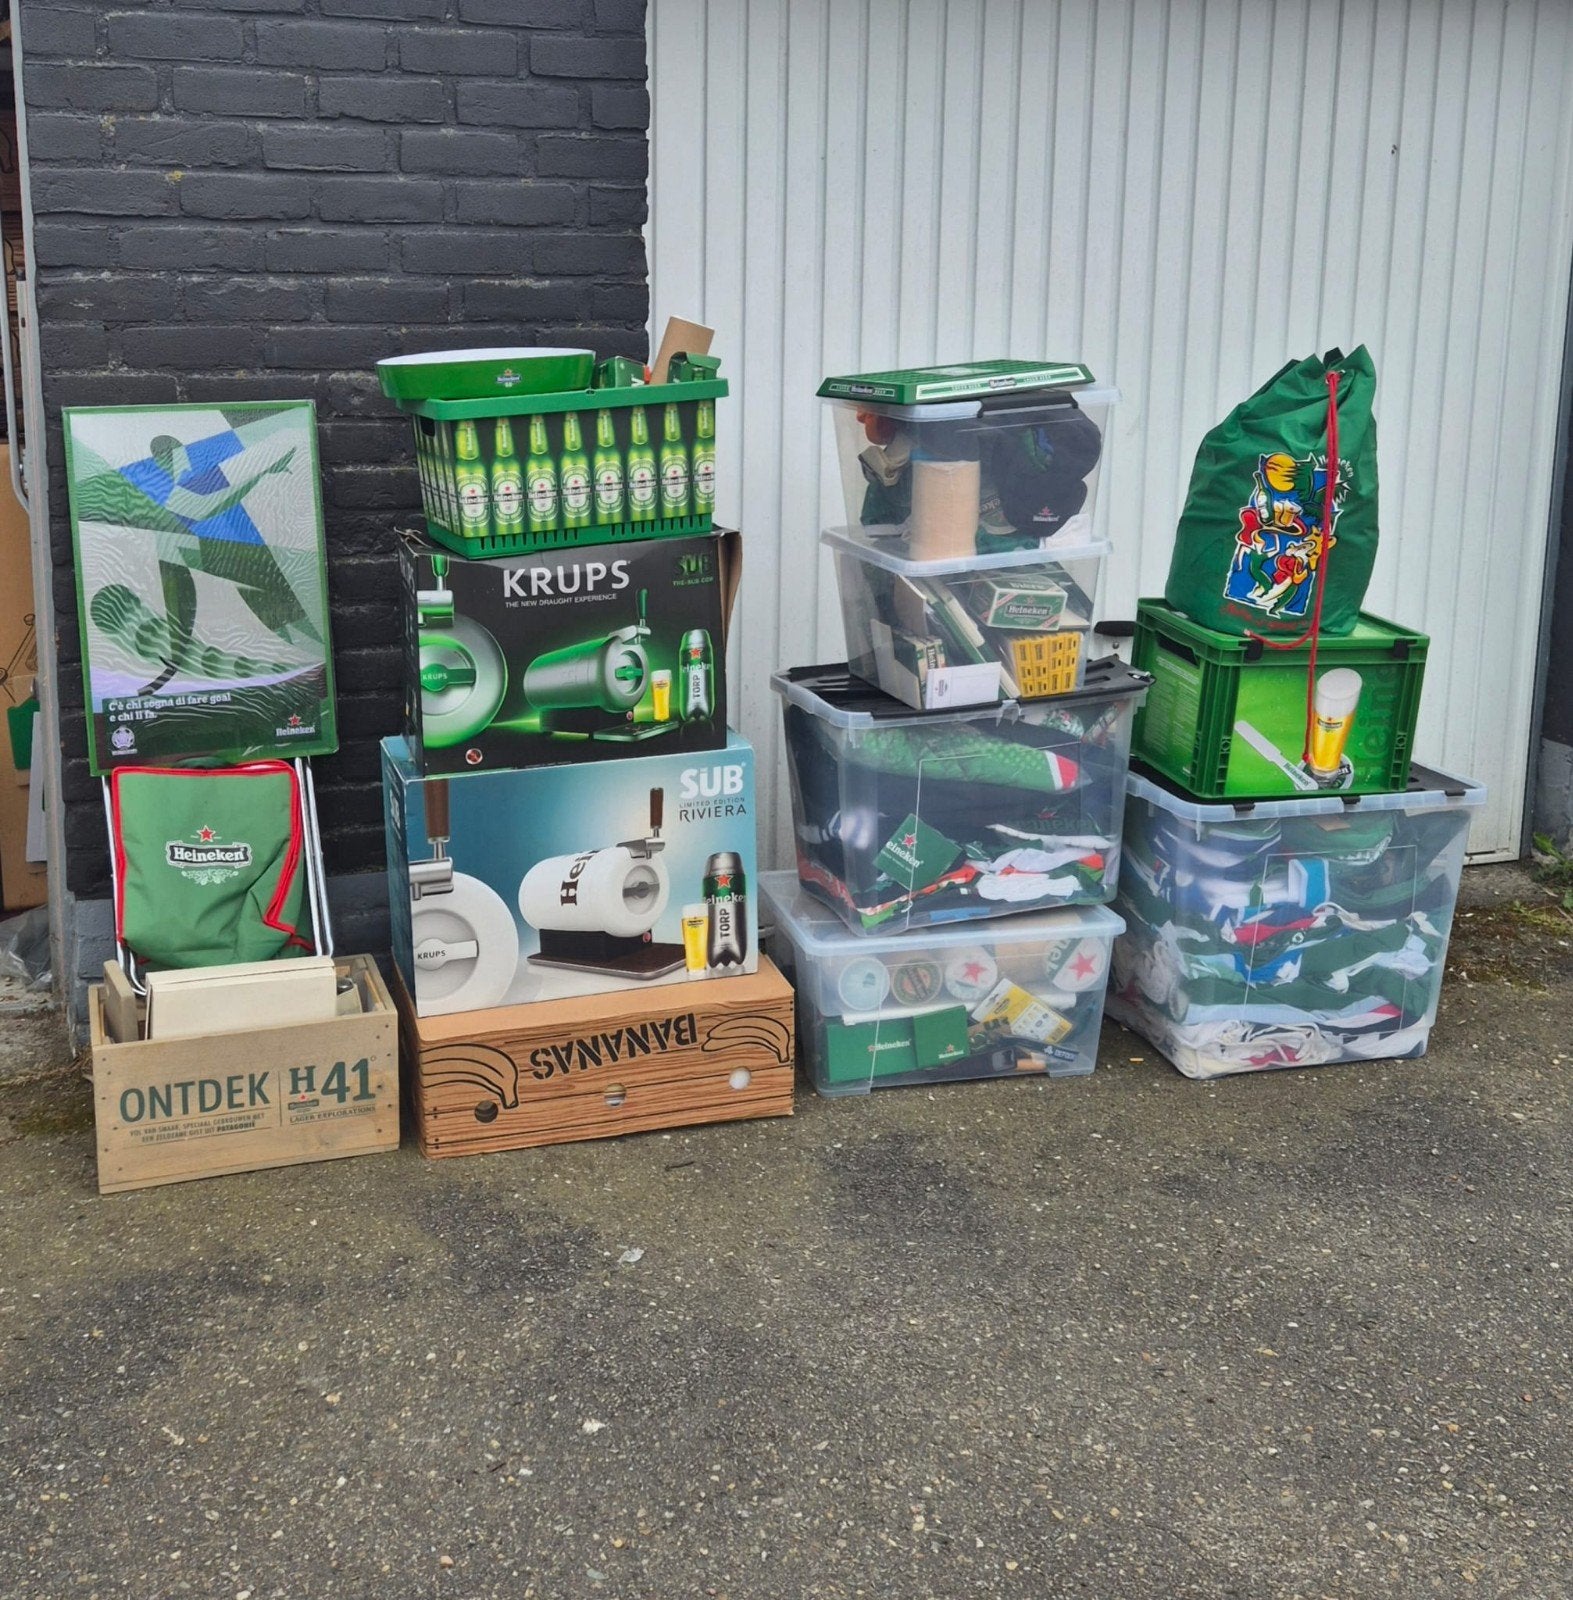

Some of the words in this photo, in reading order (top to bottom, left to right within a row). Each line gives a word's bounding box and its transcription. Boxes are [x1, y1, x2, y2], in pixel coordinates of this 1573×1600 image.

[503, 560, 630, 598] KRUPS
[505, 601, 519, 609] THE
[521, 599, 537, 608] NEW
[539, 596, 573, 606] DRAUGHT
[574, 593, 617, 603] EXPERIENCE
[1009, 605, 1048, 615] Heineken
[422, 672, 448, 681] KRUPS
[693, 674, 701, 698] TORP
[109, 701, 124, 712] C'è
[126, 699, 142, 710] chi
[144, 697, 174, 709] sogna
[175, 696, 186, 706] di
[188, 694, 208, 705] fare
[210, 693, 231, 705] goal
[118, 711, 133, 722] chi
[276, 726, 315, 737] Heineken
[679, 800, 710, 808] LIMITED
[713, 797, 745, 805] EDITION
[679, 804, 747, 822] RIVIERA
[173, 847, 245, 862] Heineken
[719, 908, 730, 938] TORP
[417, 949, 446, 960] KRUPS
[530, 1013, 698, 1080] BANANAS
[119, 1072, 270, 1123] ONTDEK
[290, 1115, 315, 1123] LAGER
[317, 1106, 376, 1119] EXPLORATIONS
